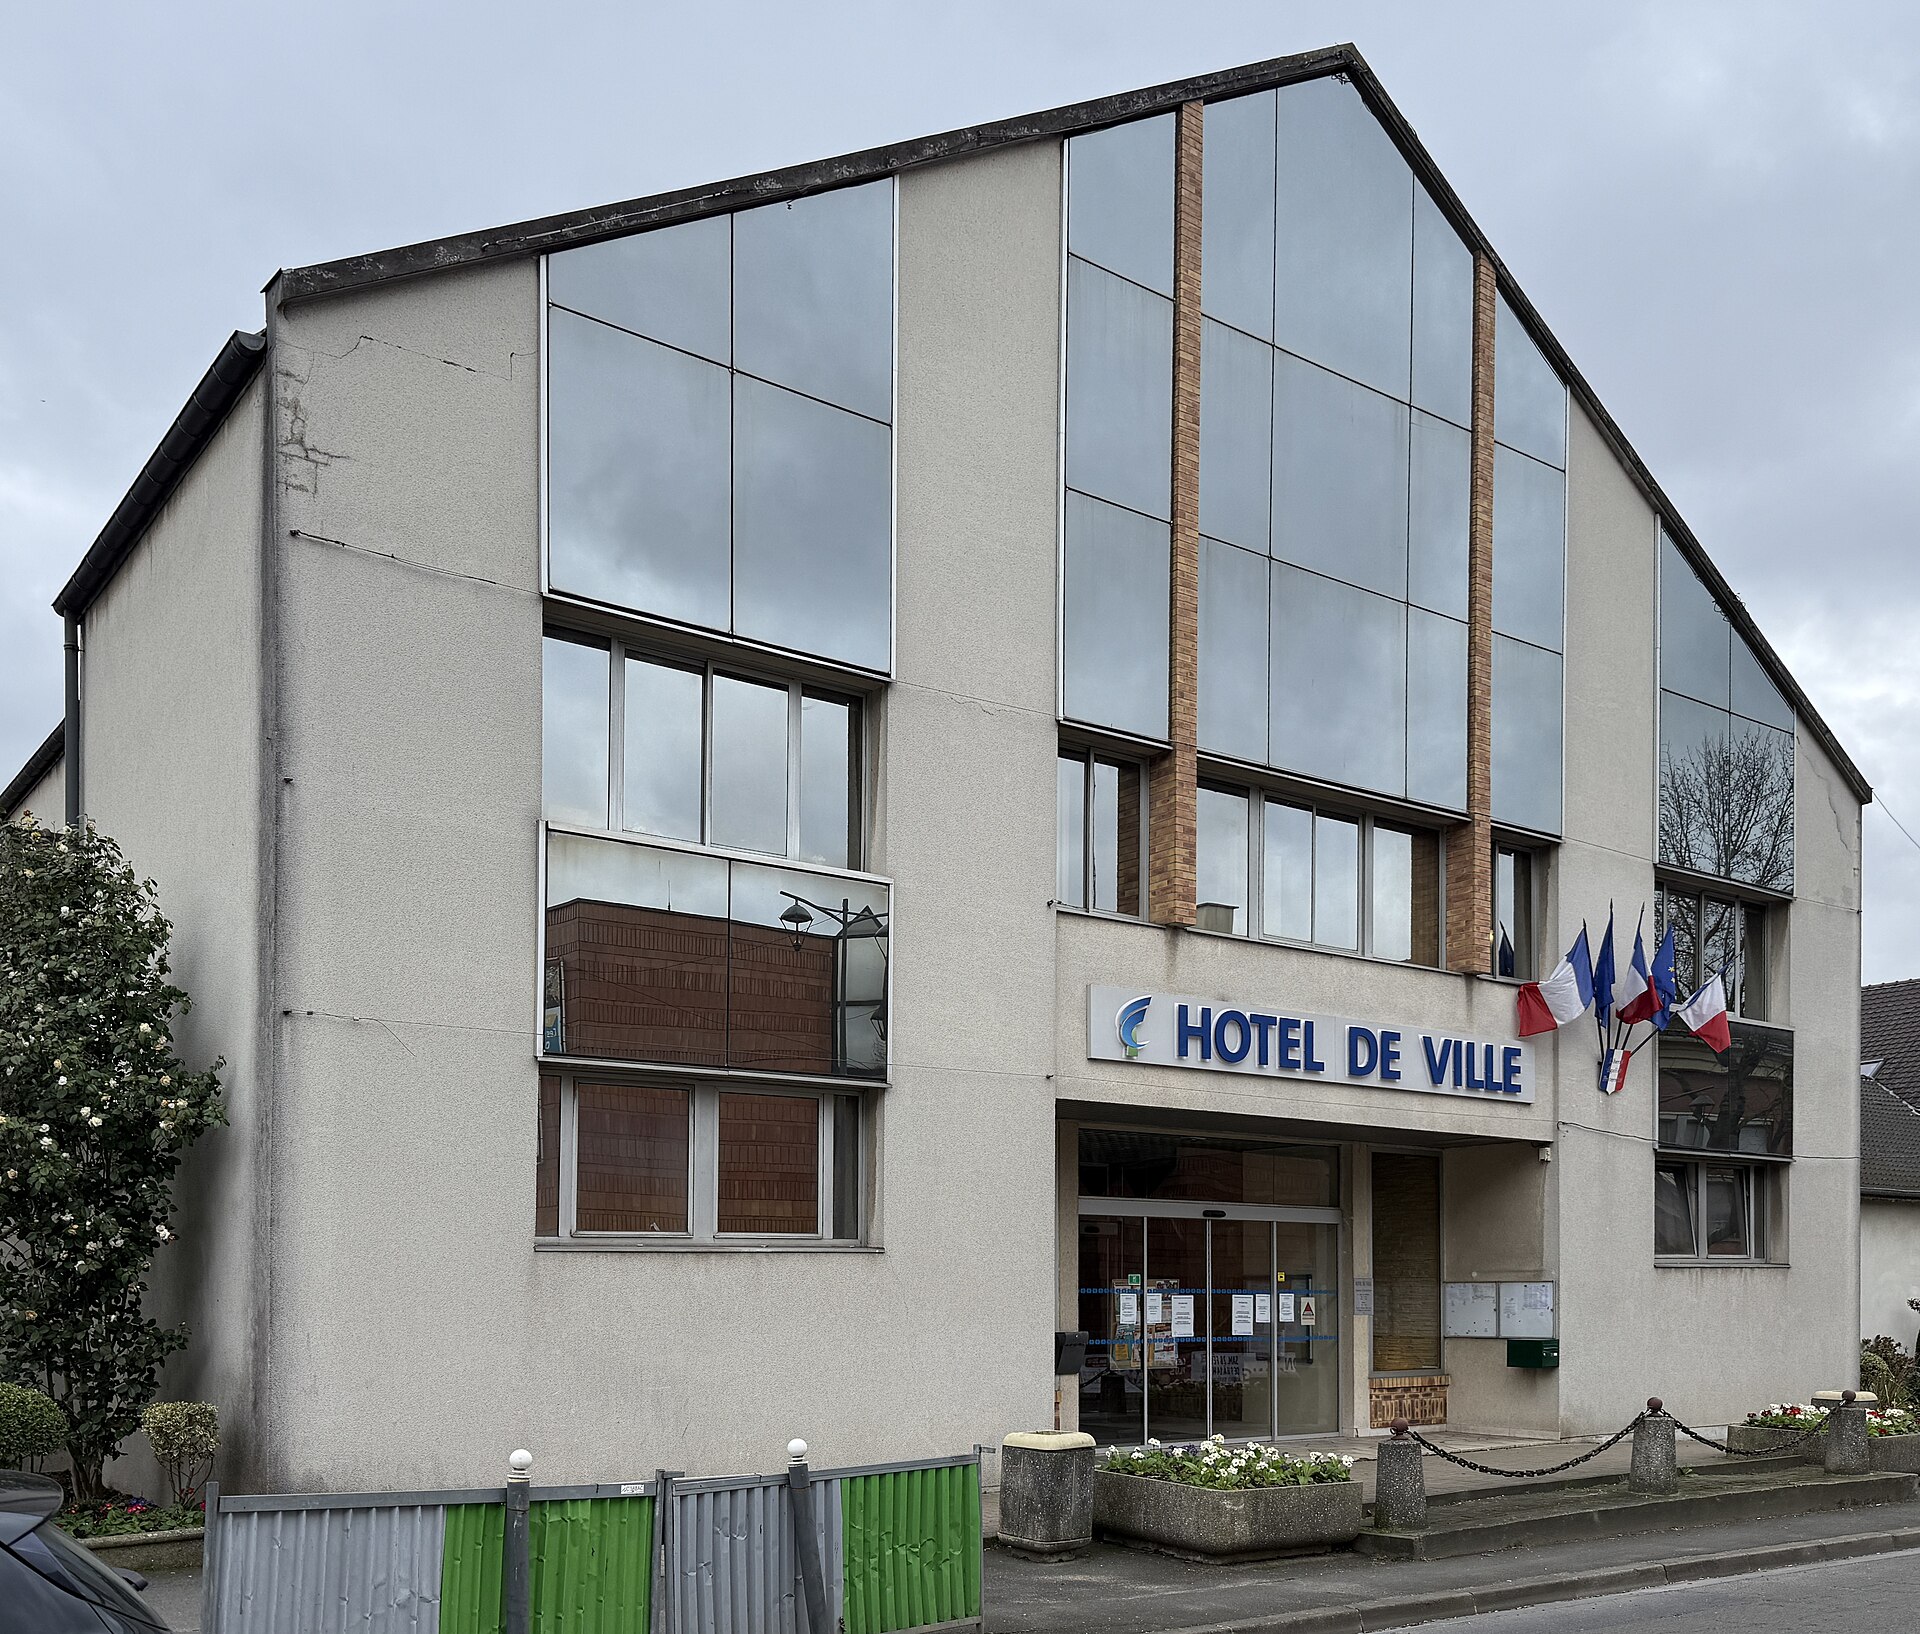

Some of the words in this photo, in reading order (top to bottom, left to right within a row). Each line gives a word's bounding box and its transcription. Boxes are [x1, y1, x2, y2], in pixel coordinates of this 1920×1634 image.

[1177, 1003, 1325, 1073] HOTEL
[1348, 1026, 1402, 1080] DE
[1423, 1036, 1522, 1094] VILLE
